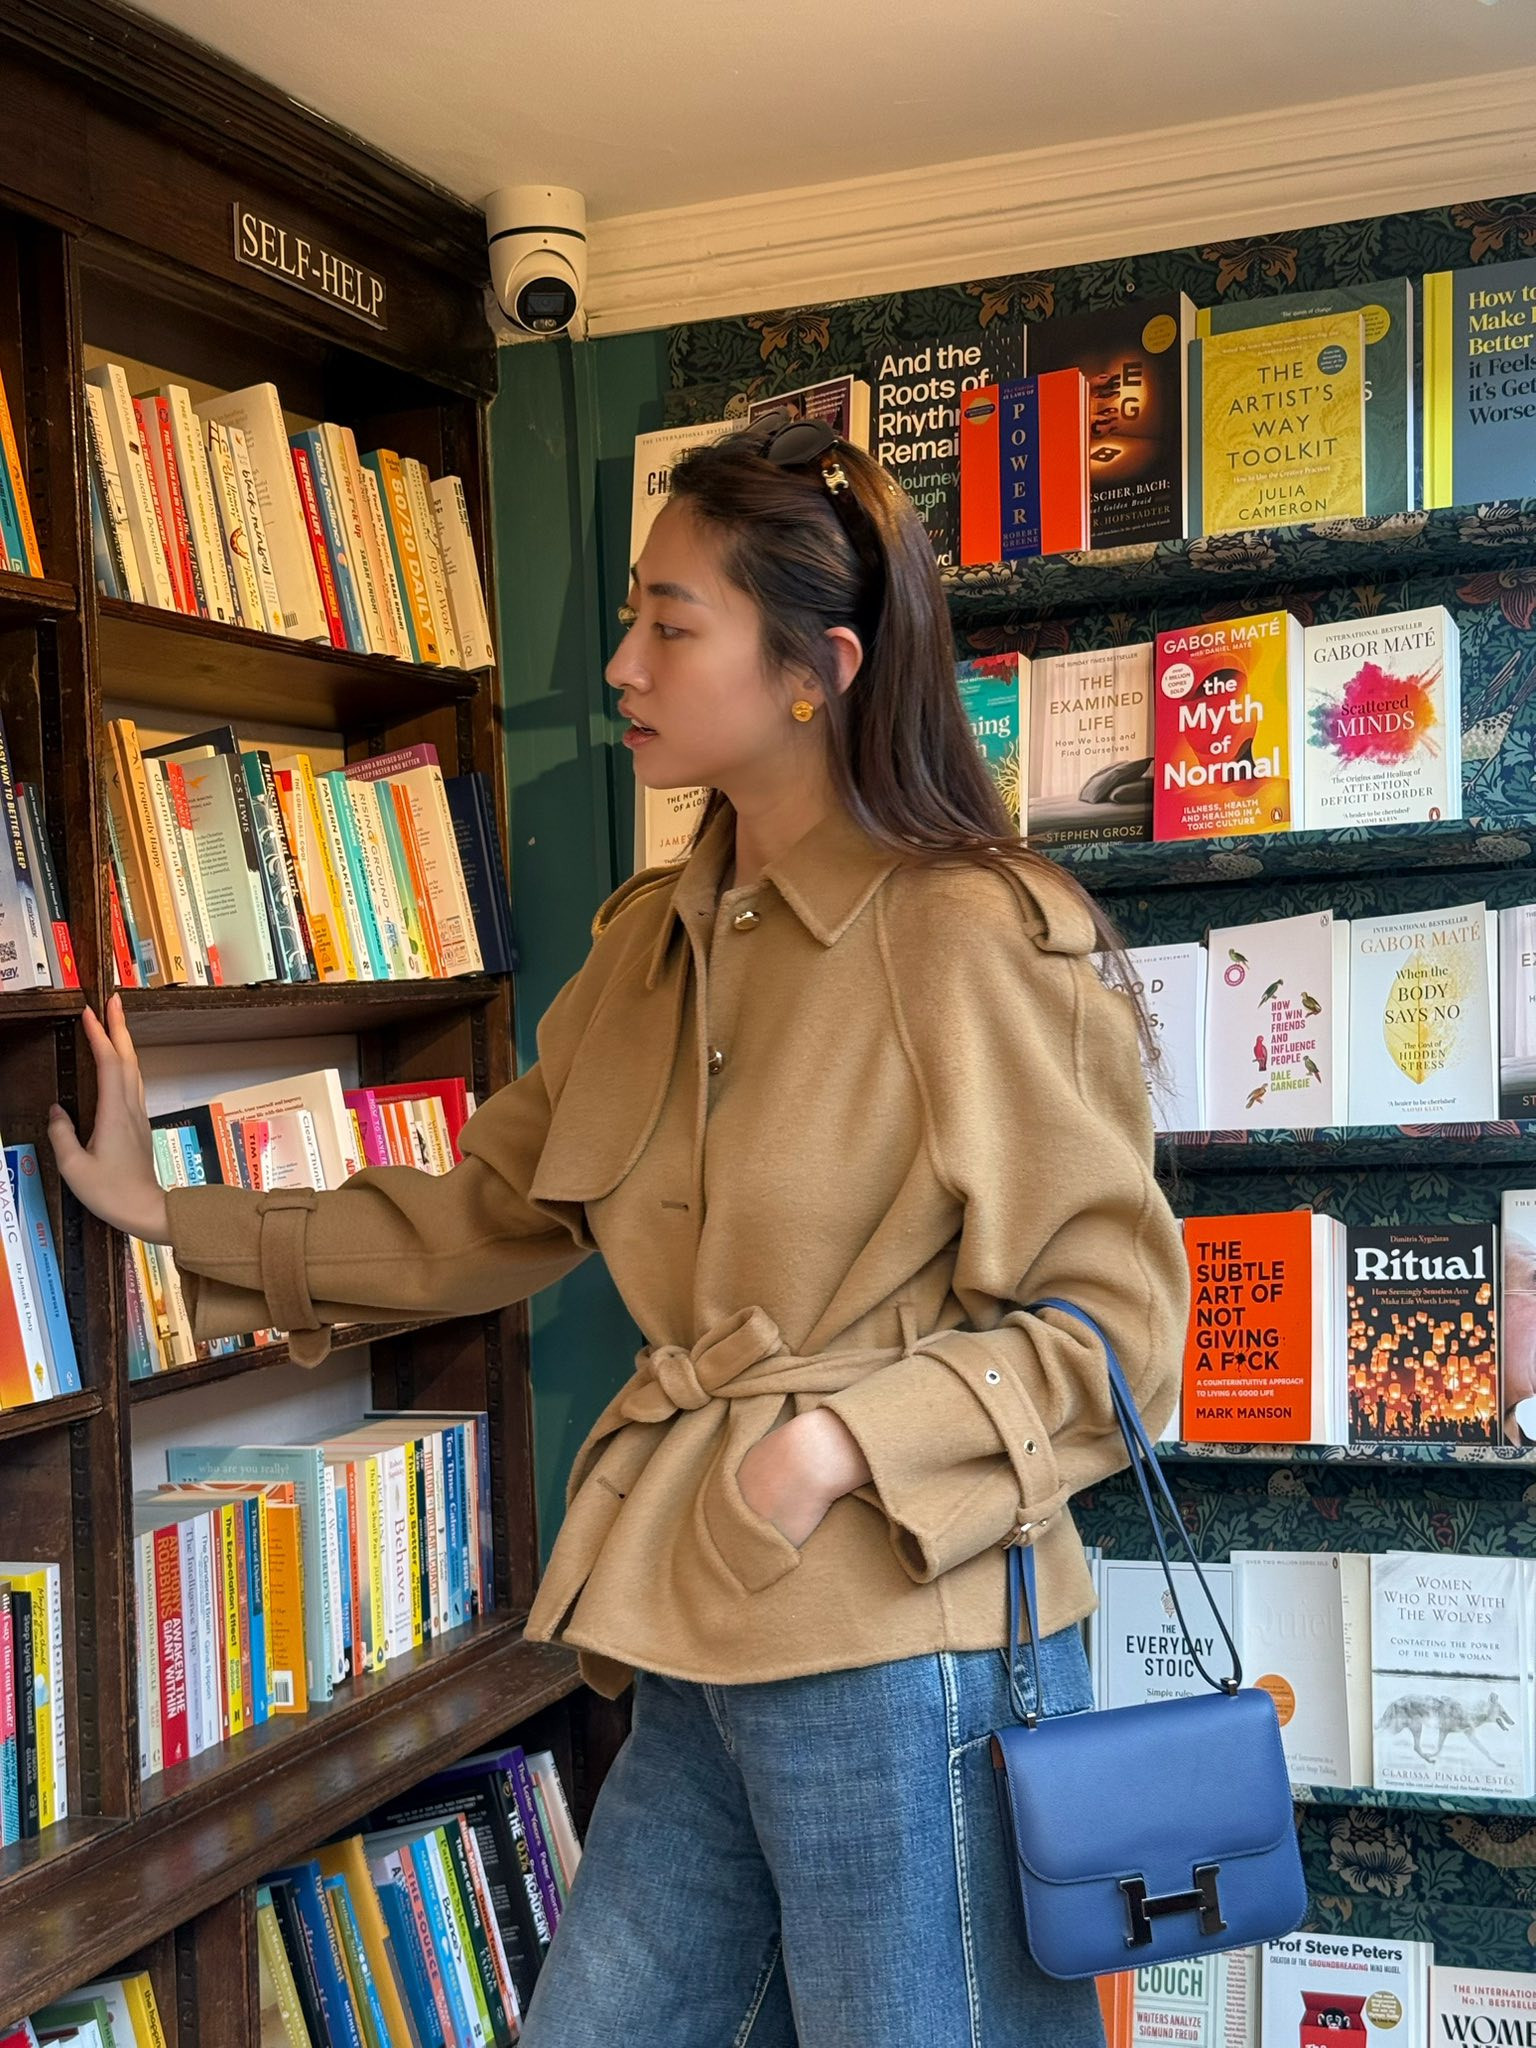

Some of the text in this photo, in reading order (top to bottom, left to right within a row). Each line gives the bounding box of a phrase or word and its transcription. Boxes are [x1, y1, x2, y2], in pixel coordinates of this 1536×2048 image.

[242, 213, 384, 318] SELF-HELP
[1469, 290, 1516, 310] How
[1469, 310, 1526, 333] Make
[1469, 333, 1534, 356] Better
[879, 344, 982, 381] And the
[1257, 361, 1303, 384] THE
[1469, 361, 1482, 379] it
[879, 377, 956, 410] Roots
[961, 368, 990, 392] of
[1229, 384, 1333, 416] ARTIST'S
[1469, 403, 1535, 425] Worse
[1252, 414, 1310, 438] WAY
[879, 432, 960, 467] Remai
[1226, 438, 1338, 469] TOOLKIT
[314, 441, 342, 547] Raising Resilience
[1090, 479, 1171, 502] SCHER, BACH:
[1258, 485, 1306, 504] JULIA
[135, 462, 163, 565] Contented Dementia
[1238, 498, 1327, 521] CAMERON
[241, 469, 271, 575] black rainbow
[391, 477, 433, 635] 80/20 DAILY
[427, 553, 453, 636] Joy at Work
[1163, 617, 1280, 654] GABOR MATÉ
[1313, 626, 1436, 664] GABOR MATÉ
[1080, 674, 1113, 690] THE
[1203, 676, 1238, 696] the
[1050, 691, 1144, 715] EXAMINED
[1179, 693, 1264, 735] Myth
[1341, 694, 1409, 716] Scattered
[1079, 716, 1114, 731] LIFE
[1336, 710, 1415, 738] MINDS
[1055, 739, 1074, 747] How
[1078, 737, 1091, 745] We
[1120, 732, 1136, 740] and
[1061, 745, 1130, 757] Find Ourselves
[1210, 735, 1232, 755] of
[1163, 746, 1280, 790] Normal
[1321, 786, 1434, 807] DEFICIT DISORDER
[1342, 778, 1411, 794] ATTENTION
[8, 803, 20, 840] BETTER
[16, 841, 26, 870] SLEEP
[154, 773, 187, 896] dopamine nation
[321, 783, 354, 906] PATTERN BREAKERS
[1046, 825, 1143, 843] STEPHEN GROSZ
[1360, 920, 1480, 954] GABOR MATÉ
[1395, 966, 1448, 980] When the
[1398, 983, 1449, 1002] BODY
[1271, 1000, 1291, 1011] HOW
[1271, 1009, 1303, 1022] TO WIN
[1385, 1004, 1460, 1025] SAYS NO
[1271, 1020, 1306, 1033] FRIENDS
[1271, 1033, 1288, 1044] AND
[1271, 1039, 1316, 1055] INFLUENCE
[1271, 1053, 1301, 1066] PEOPLE
[1399, 1049, 1446, 1061] HIDDEN
[1401, 1060, 1445, 1071] STRESS
[1271, 1069, 1291, 1082] DALE
[1271, 1078, 1310, 1092] CARNEGIE
[36, 1222, 48, 1248] GRIT
[1196, 1241, 1242, 1261] THE
[1197, 1261, 1285, 1283] SUBTLE
[1354, 1245, 1486, 1281] Ritual
[1196, 1283, 1283, 1305] ART OF
[1197, 1306, 1245, 1327] NOT
[1196, 1328, 1279, 1349] GIVING
[1196, 1352, 1213, 1372] A
[1196, 1407, 1292, 1419] MARK MANSON
[198, 1462, 290, 1477] who are you really?
[445, 1433, 458, 1548] Ten Times Calmer
[406, 1452, 419, 1565] Thinking Better
[394, 1519, 408, 1603] Behave
[158, 1537, 172, 1618] ROBBINS
[168, 1535, 182, 1613] ANTHONY
[225, 1517, 238, 1646] The Expectation Effect
[185, 1528, 200, 1655] The Intelligence Trap
[23, 1614, 31, 1637] Stop
[1161, 1624, 1177, 1634] THE
[1126, 1635, 1214, 1656] EVERYDAY
[23, 1642, 32, 1673] Lying
[172, 1618, 185, 1712] AWAKEN THE
[1144, 1658, 1195, 1678] STOIC
[164, 1620, 176, 1719] GIANT WITHIN
[26, 1688, 35, 1734] Yourself
[506, 1810, 552, 1944] THE 0.1% ACADEMY
[406, 1872, 440, 1979] THE SOURCE
[441, 1896, 462, 1949] Bounce
[1268, 1938, 1403, 1961] Prof Steve Peters
[1137, 1964, 1203, 1998] COUCH
[1454, 1984, 1471, 1994] THE
[1462, 1996, 1484, 2006] No.1
[1136, 2011, 1202, 2028] WRITERS ANALYZE
[1441, 2013, 1536, 2047] WOME
[1139, 2025, 1199, 2041] SIGMUND FREUD
